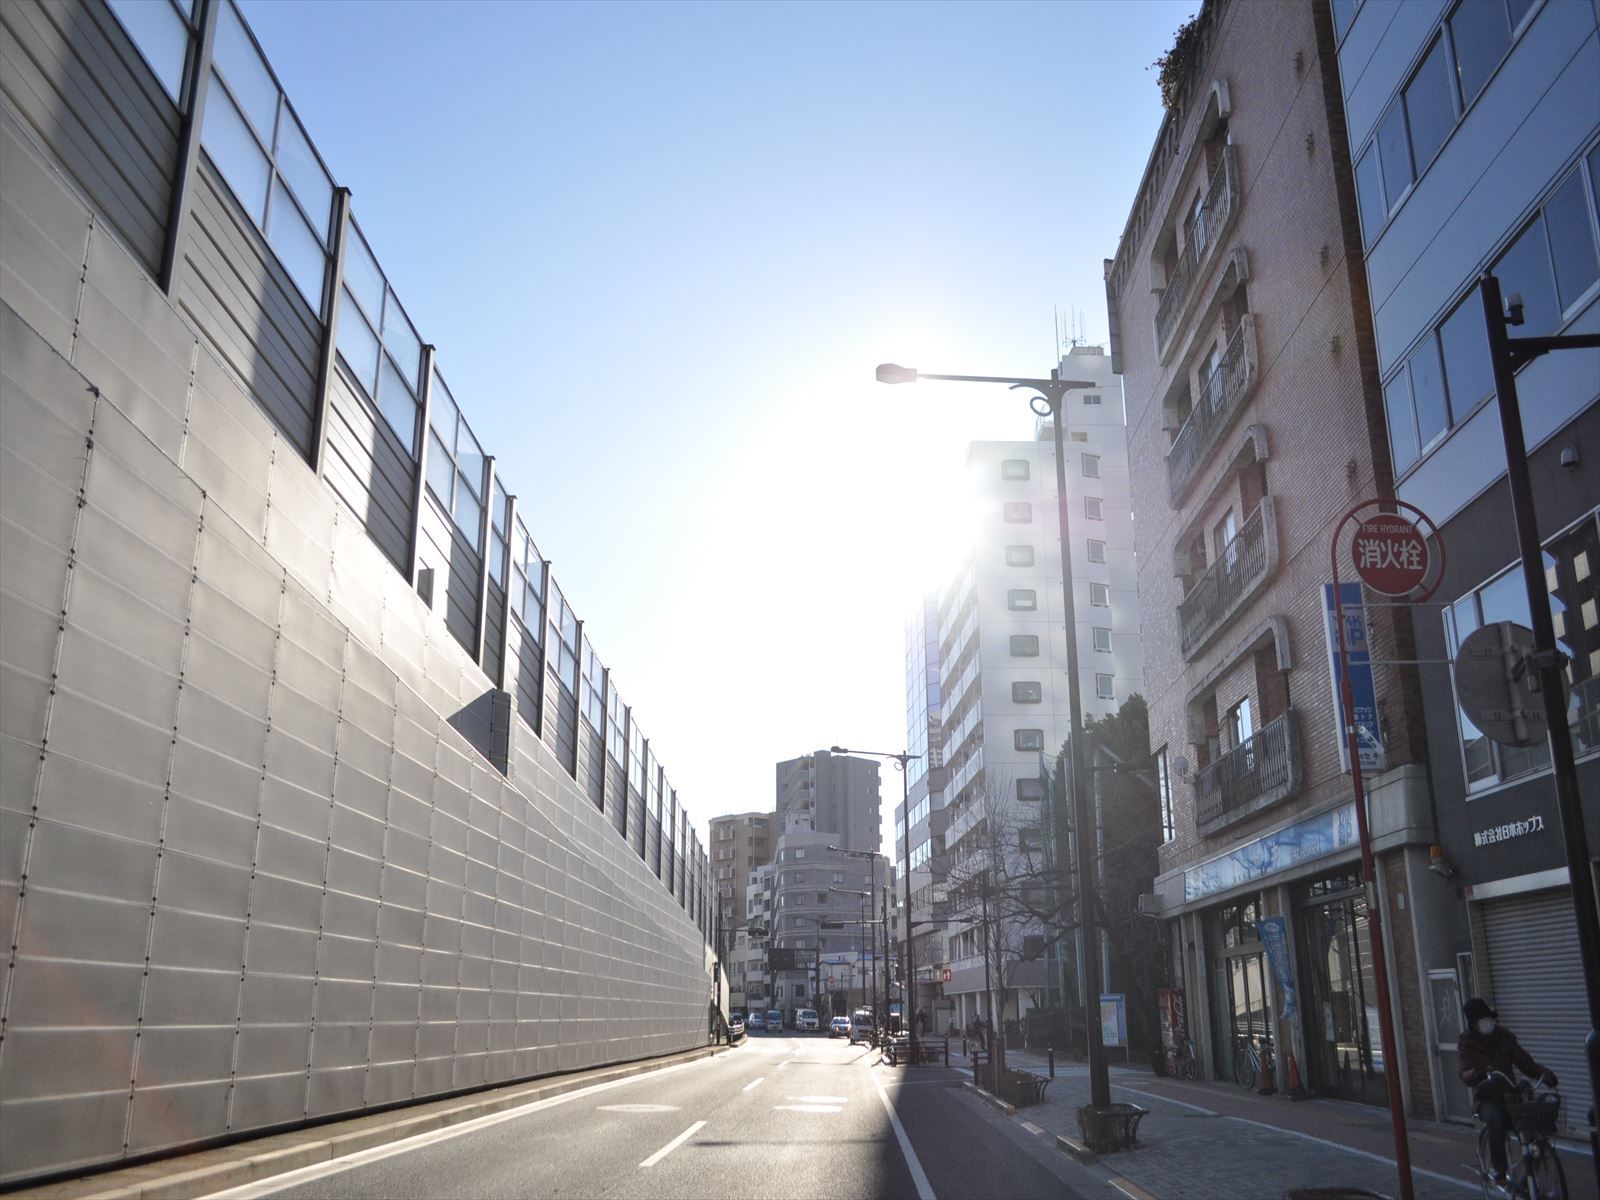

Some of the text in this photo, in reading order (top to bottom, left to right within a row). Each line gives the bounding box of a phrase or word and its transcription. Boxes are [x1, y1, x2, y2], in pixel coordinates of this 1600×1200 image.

[1362, 524, 1413, 534] FIRE HYDRANT
[1358, 538, 1423, 570] 消火栓
